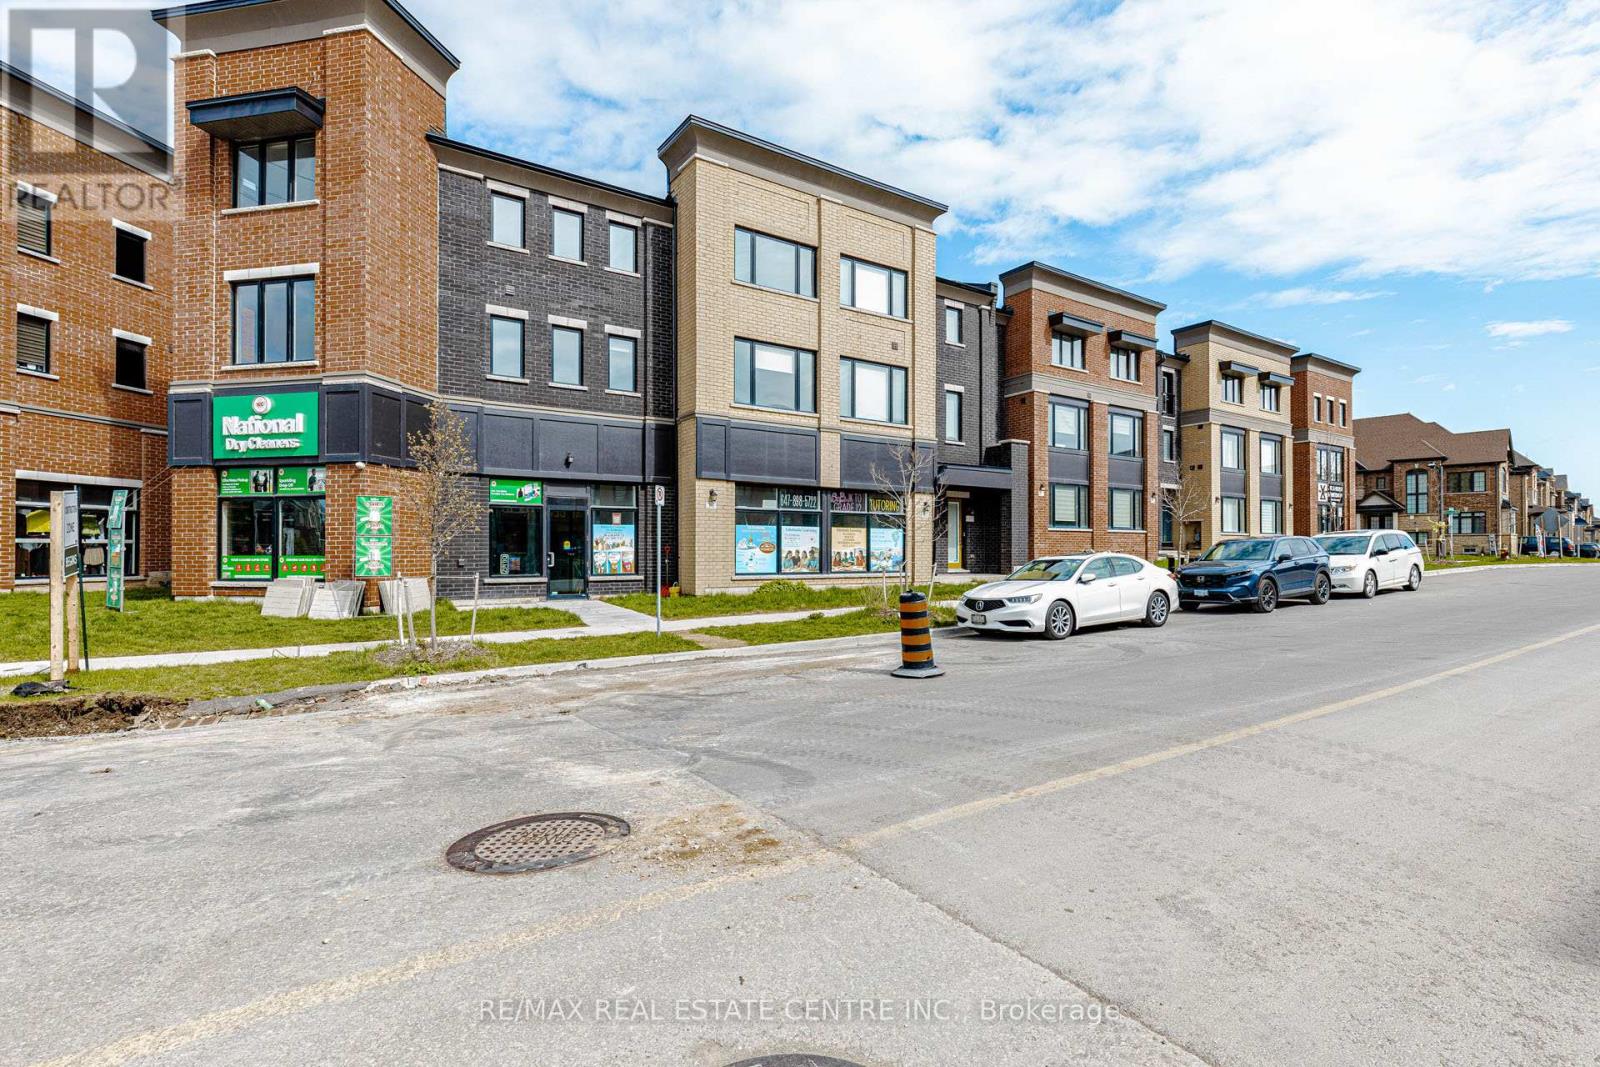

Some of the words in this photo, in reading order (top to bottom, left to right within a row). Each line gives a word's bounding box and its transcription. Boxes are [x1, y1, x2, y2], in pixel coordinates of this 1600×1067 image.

[222, 413, 304, 435] National
[225, 438, 248, 453] Dry
[248, 437, 300, 450] Cleaners
[870, 499, 900, 512] TUTORING
